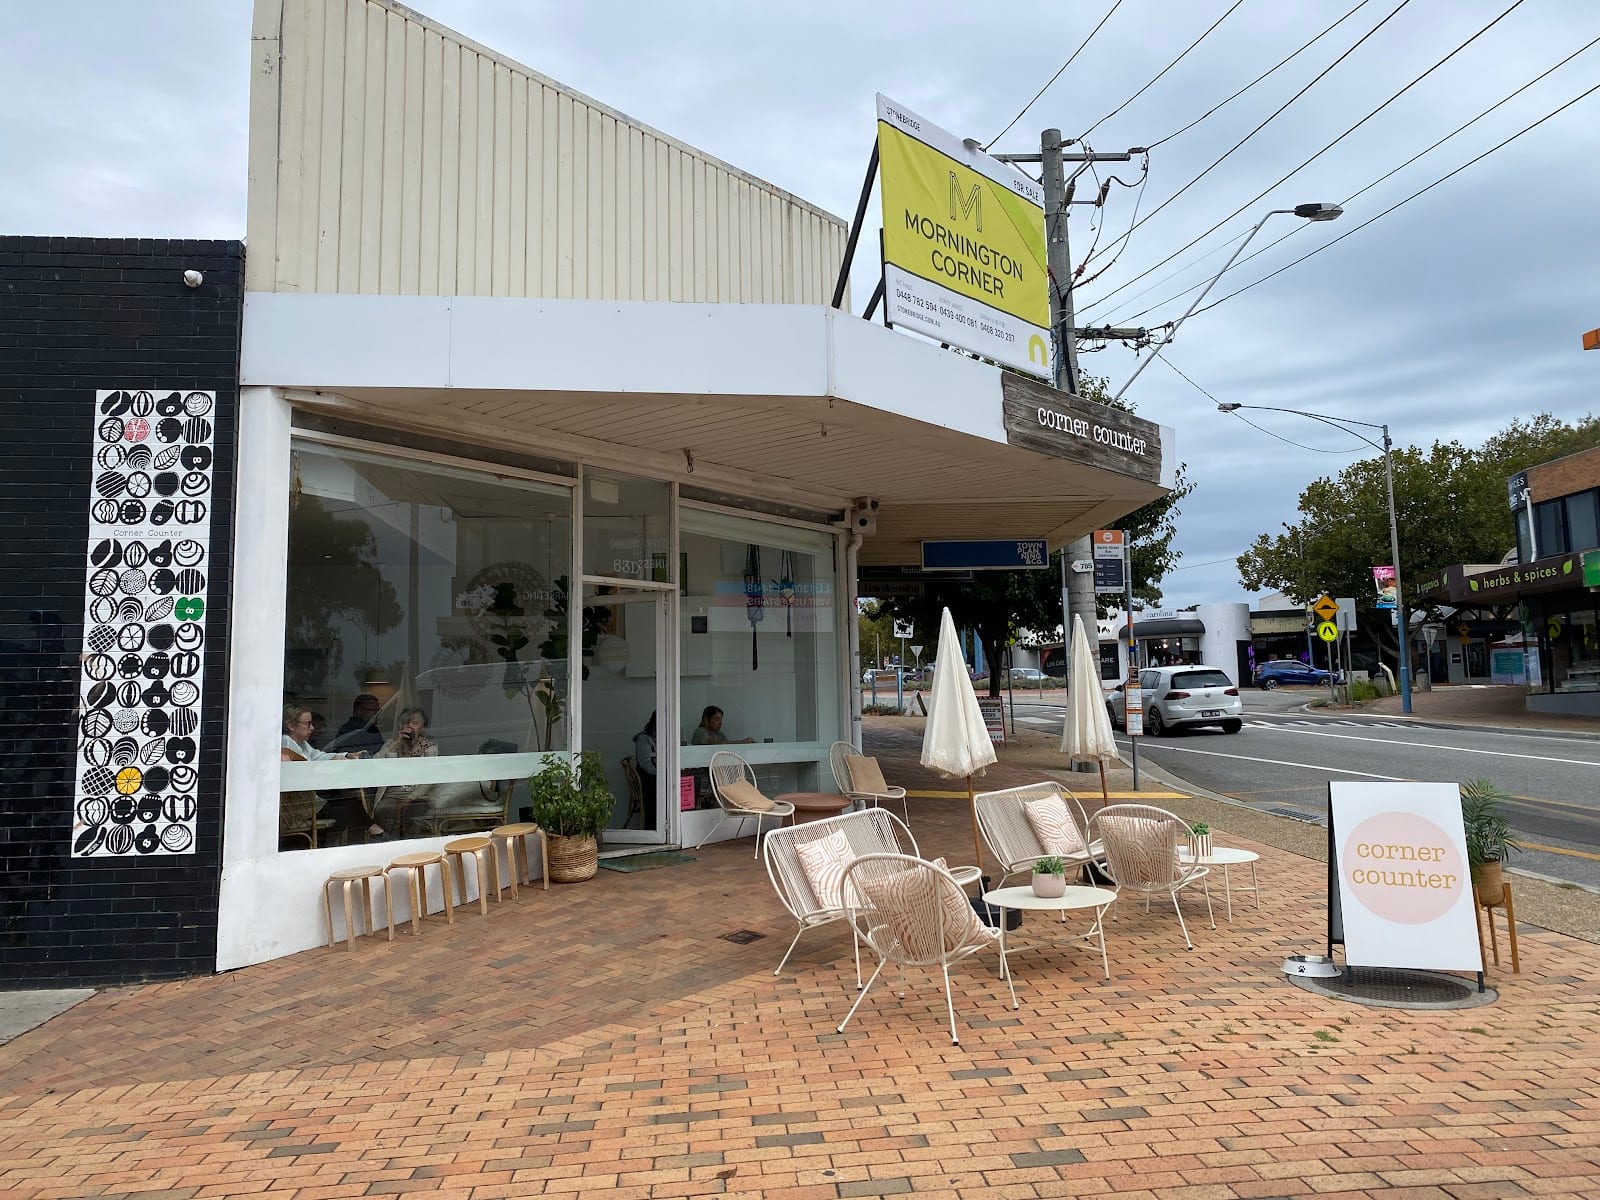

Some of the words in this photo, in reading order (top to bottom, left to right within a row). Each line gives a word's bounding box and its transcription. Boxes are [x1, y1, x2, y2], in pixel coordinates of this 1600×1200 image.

[1013, 179, 1025, 193] FOR
[1025, 186, 1039, 201] SALE
[905, 208, 1023, 282] MORNINGTON
[931, 249, 1005, 299] CORNER
[1037, 407, 1090, 438] corner
[1093, 424, 1147, 456] counter
[114, 529, 144, 537] Corner
[148, 529, 183, 537] Counter
[1483, 571, 1511, 589] herbs
[1513, 571, 1521, 583] &
[1524, 566, 1557, 584] spices
[1146, 610, 1173, 618] carolina
[1356, 843, 1446, 862] corner
[1352, 868, 1457, 889] counter
